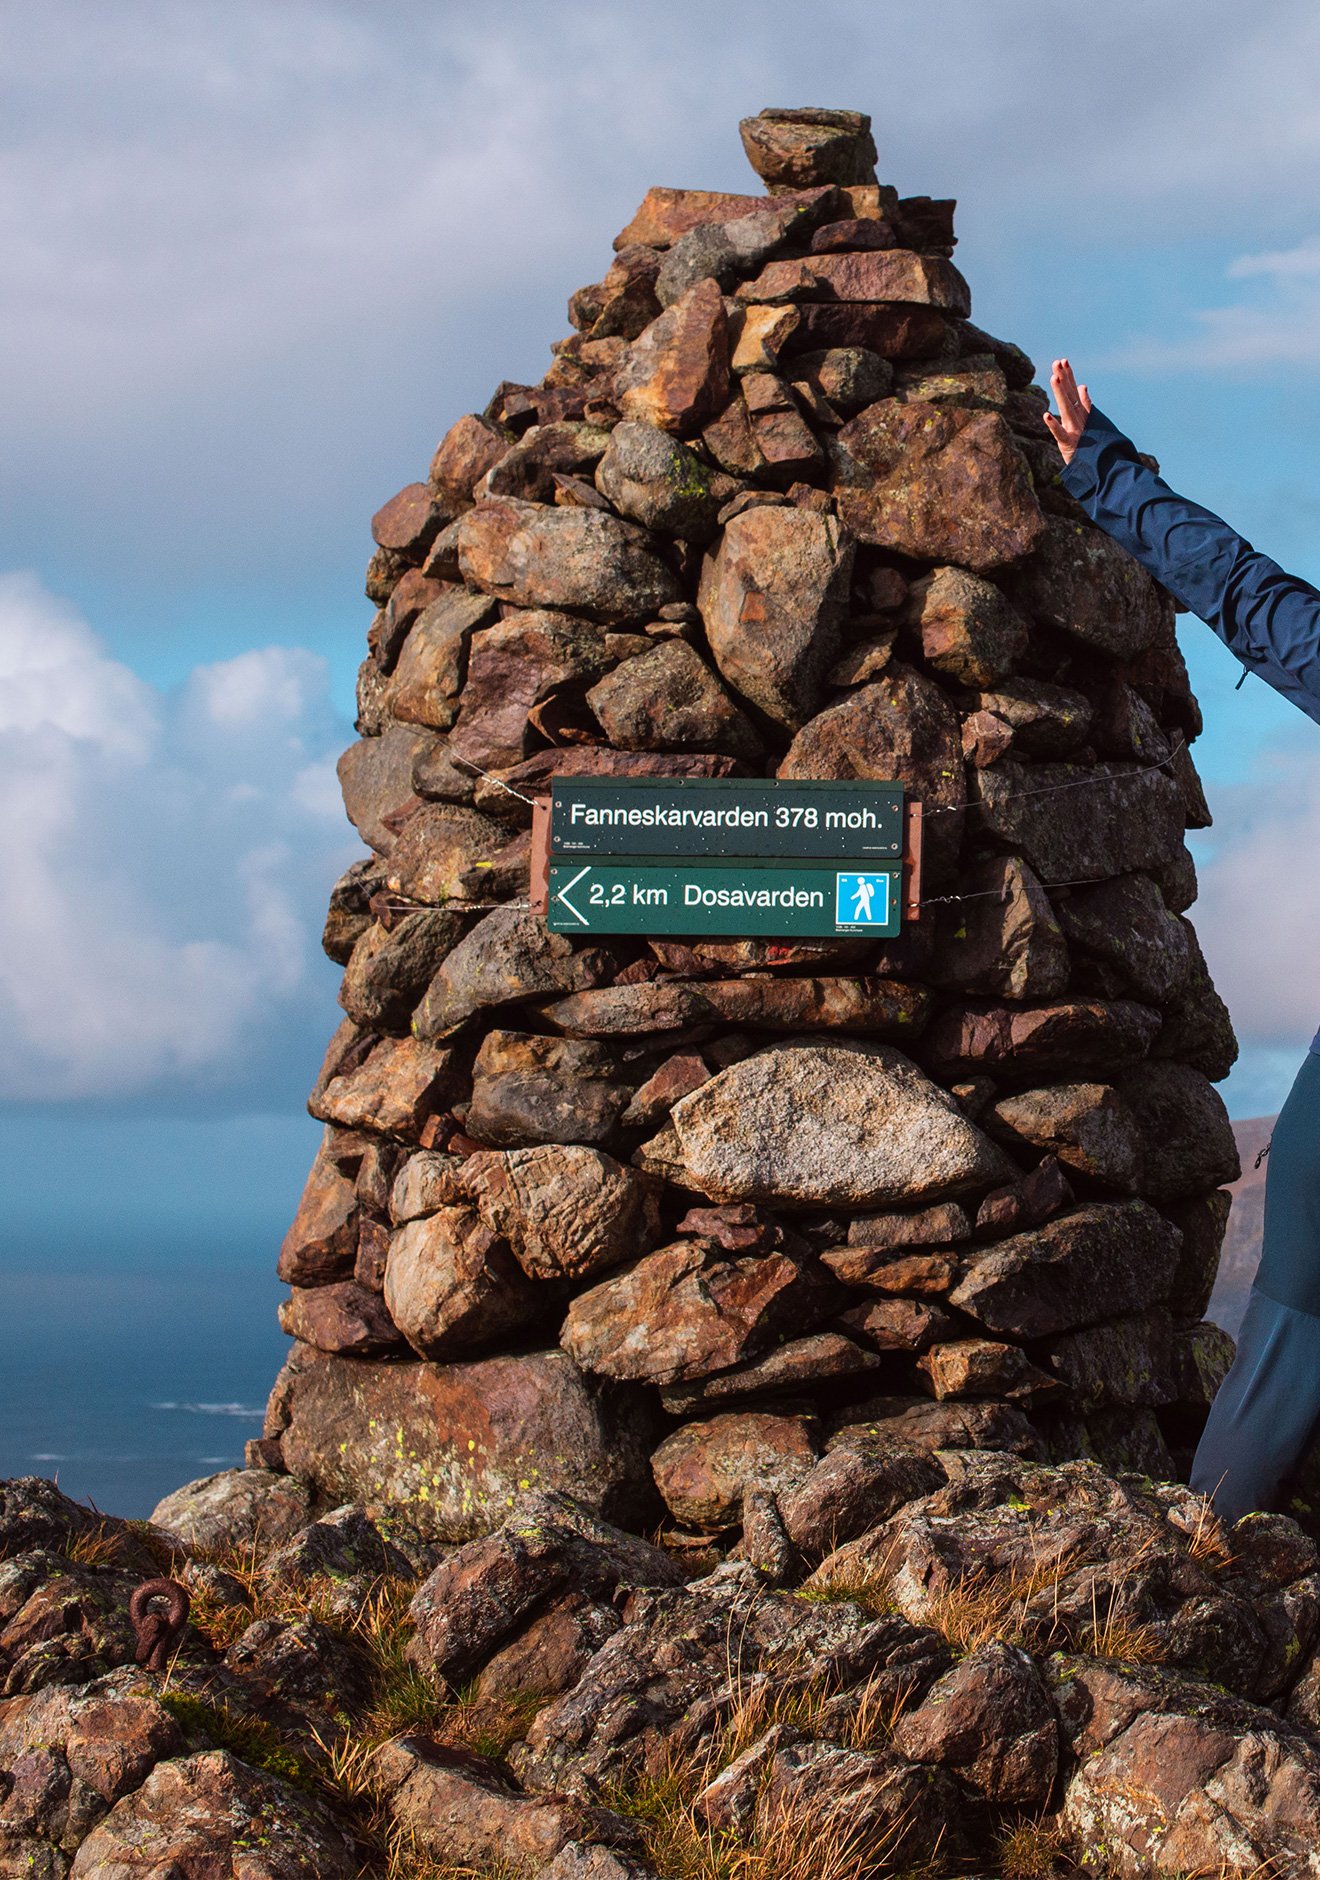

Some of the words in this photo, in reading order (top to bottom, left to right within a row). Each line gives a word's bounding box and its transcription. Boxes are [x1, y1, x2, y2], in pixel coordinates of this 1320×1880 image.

[571, 803, 769, 828] Fanneskarvarden
[775, 806, 818, 829] 378
[826, 808, 883, 829] moh.
[589, 883, 627, 908] 2,2
[633, 884, 668, 906] km
[684, 885, 824, 908] Dosavarden
